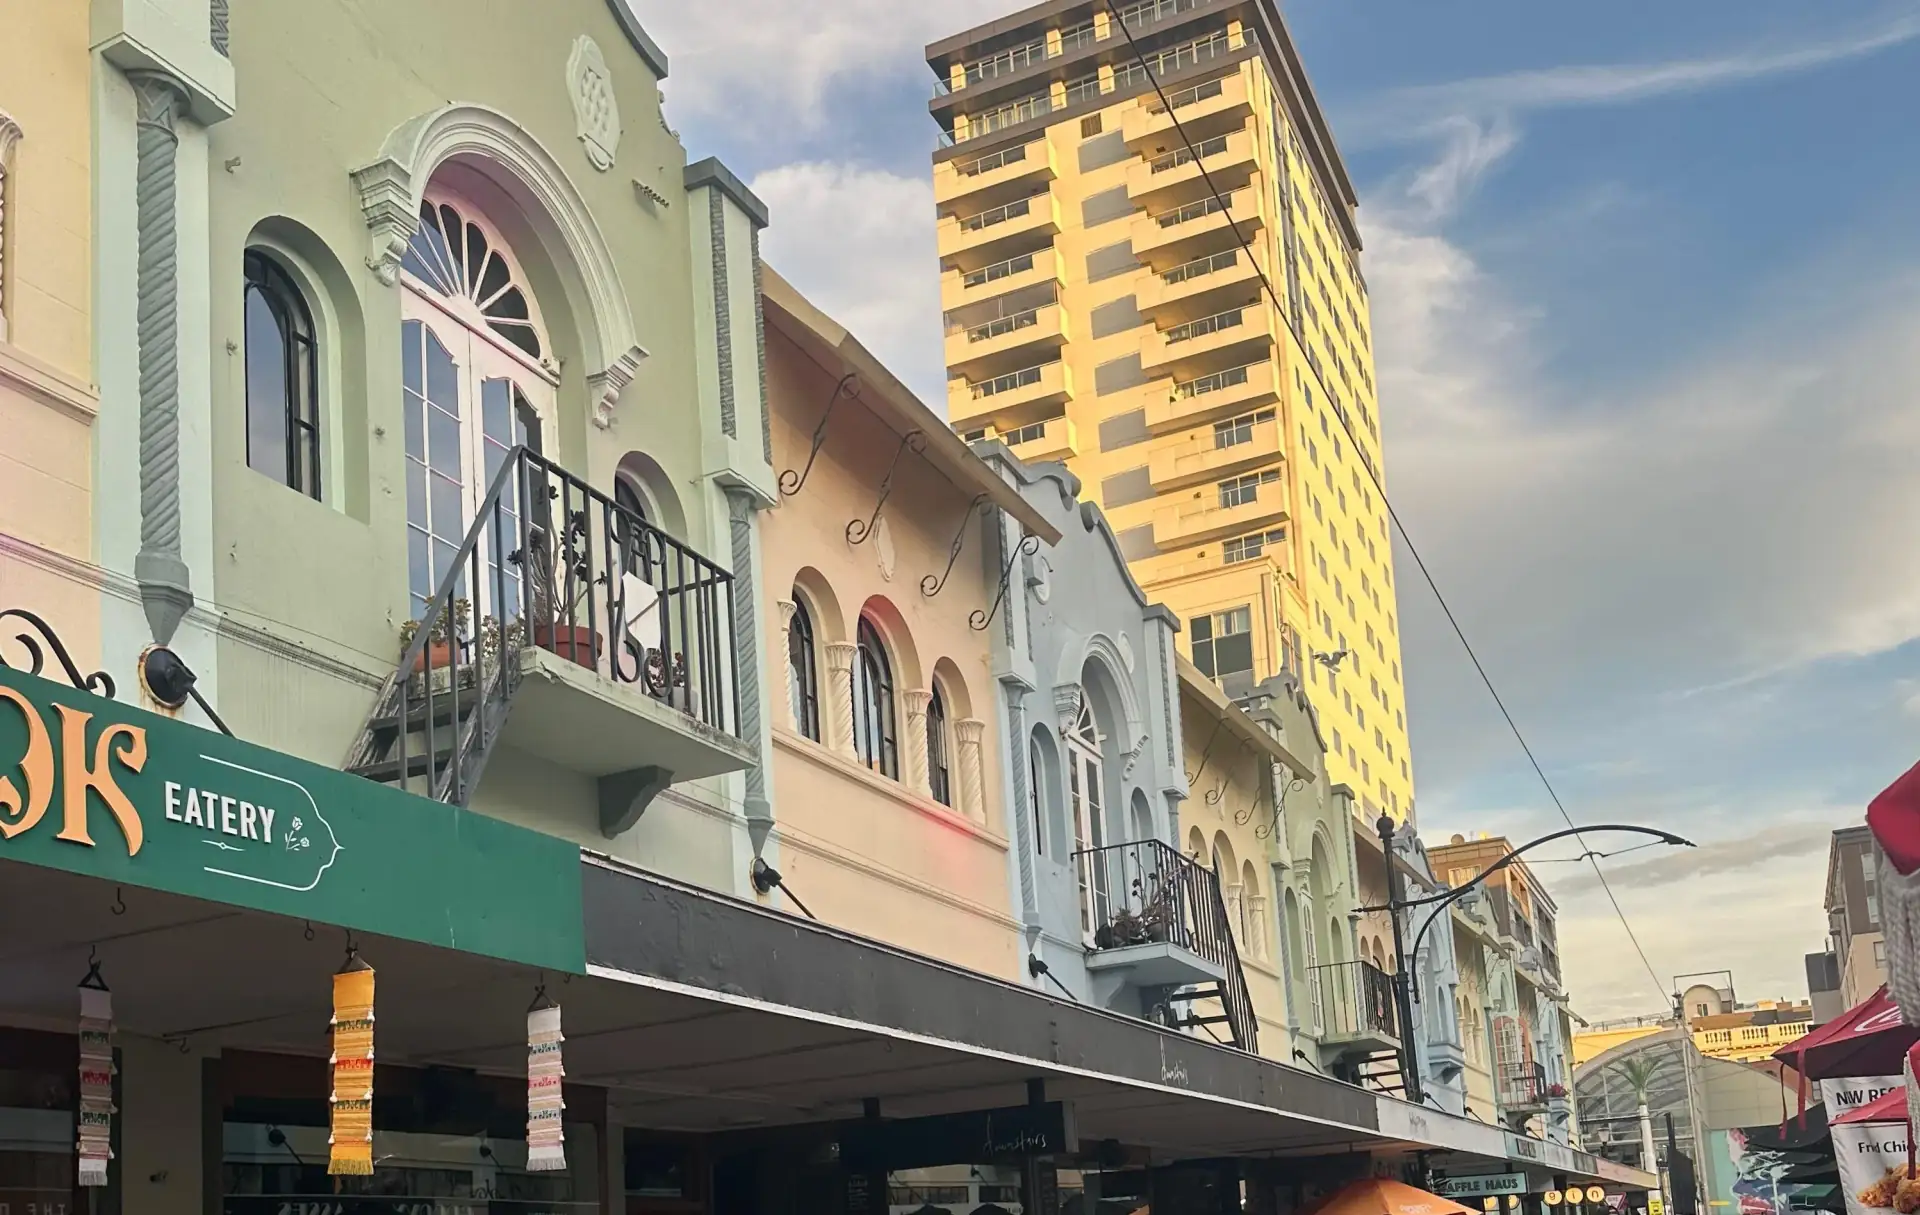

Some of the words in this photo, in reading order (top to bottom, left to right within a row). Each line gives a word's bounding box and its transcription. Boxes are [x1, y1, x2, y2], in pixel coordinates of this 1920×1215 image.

[165, 781, 275, 844] EATERY
[1883, 1140, 1908, 1153] Chi
[1441, 1179, 1480, 1193] AFFLE
[1485, 1178, 1518, 1190] HAUS
